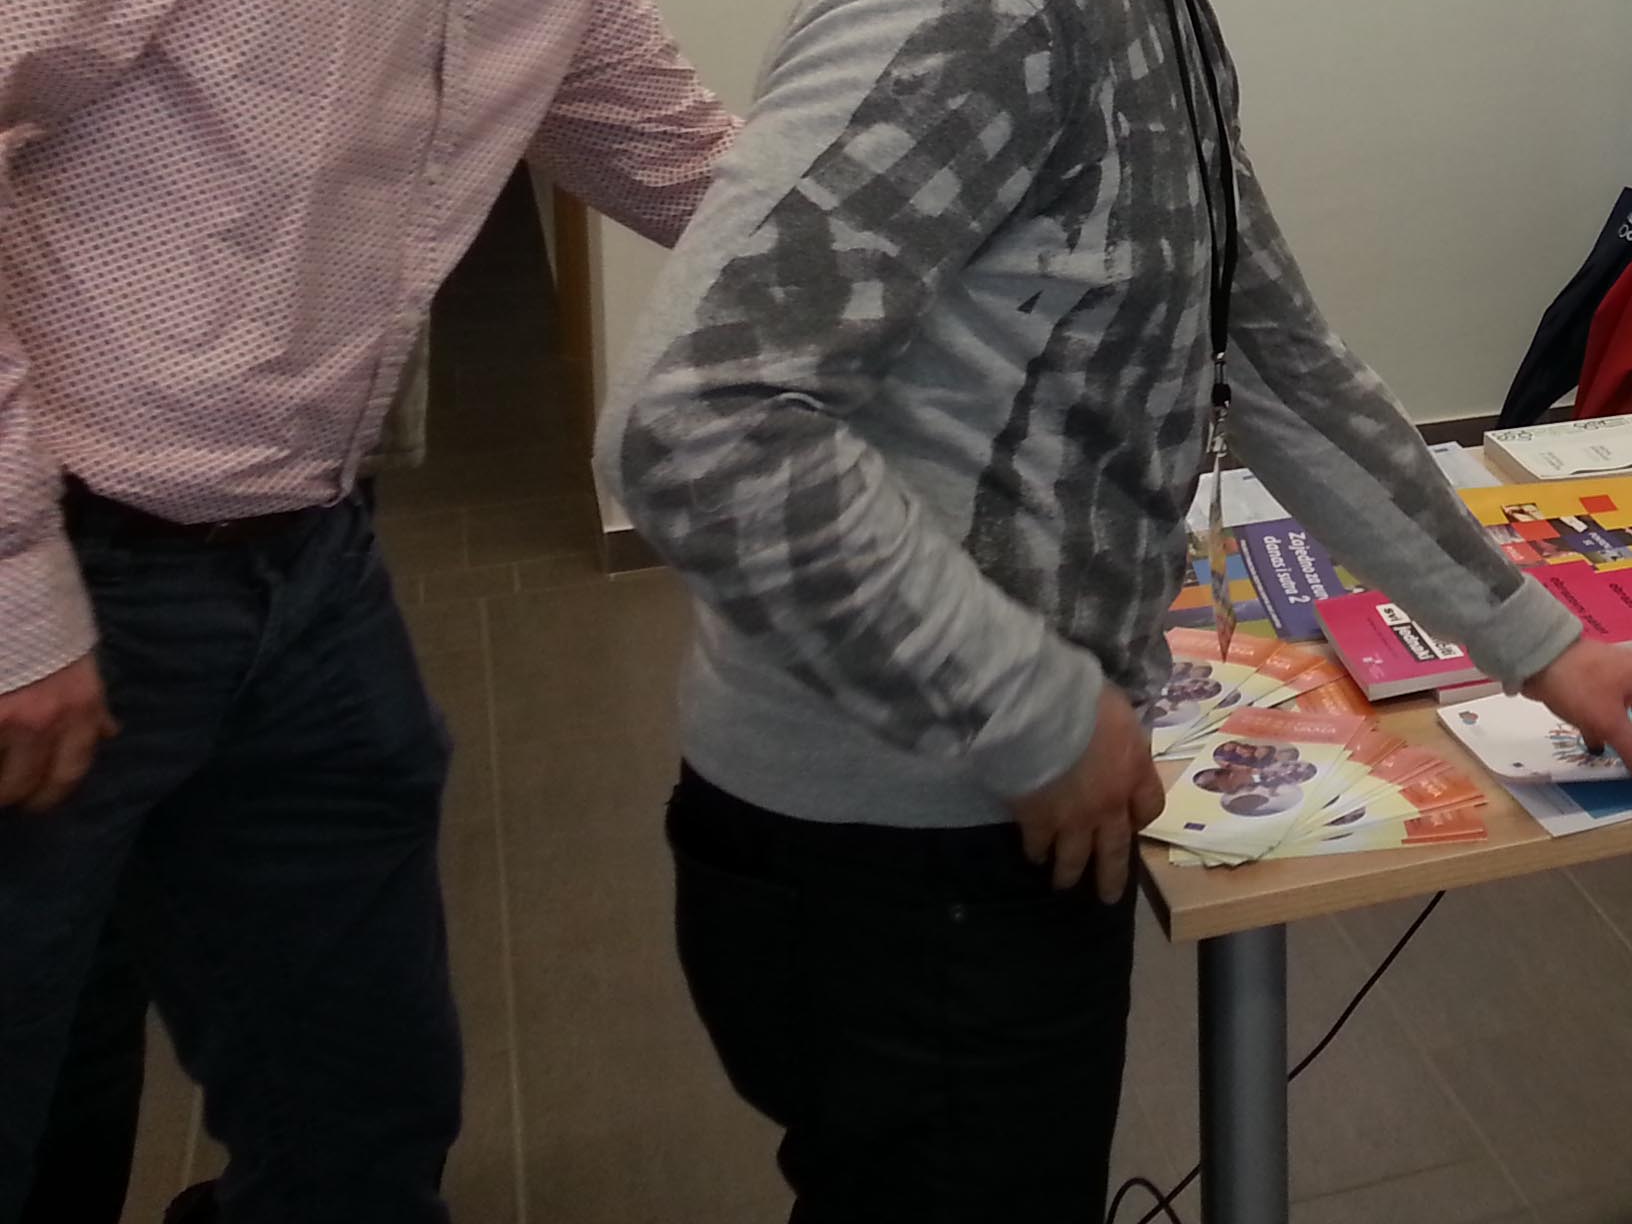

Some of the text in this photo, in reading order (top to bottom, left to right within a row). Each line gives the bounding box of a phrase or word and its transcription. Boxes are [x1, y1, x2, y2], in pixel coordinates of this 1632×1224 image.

[1263, 535, 1286, 568] danas
[1276, 572, 1298, 594] sutra
[1288, 595, 1311, 604] 2
[1288, 531, 1316, 573] Zajedno
[1305, 573, 1321, 584] za
[1384, 608, 1401, 622] svi
[1393, 625, 1435, 661] jednaki
